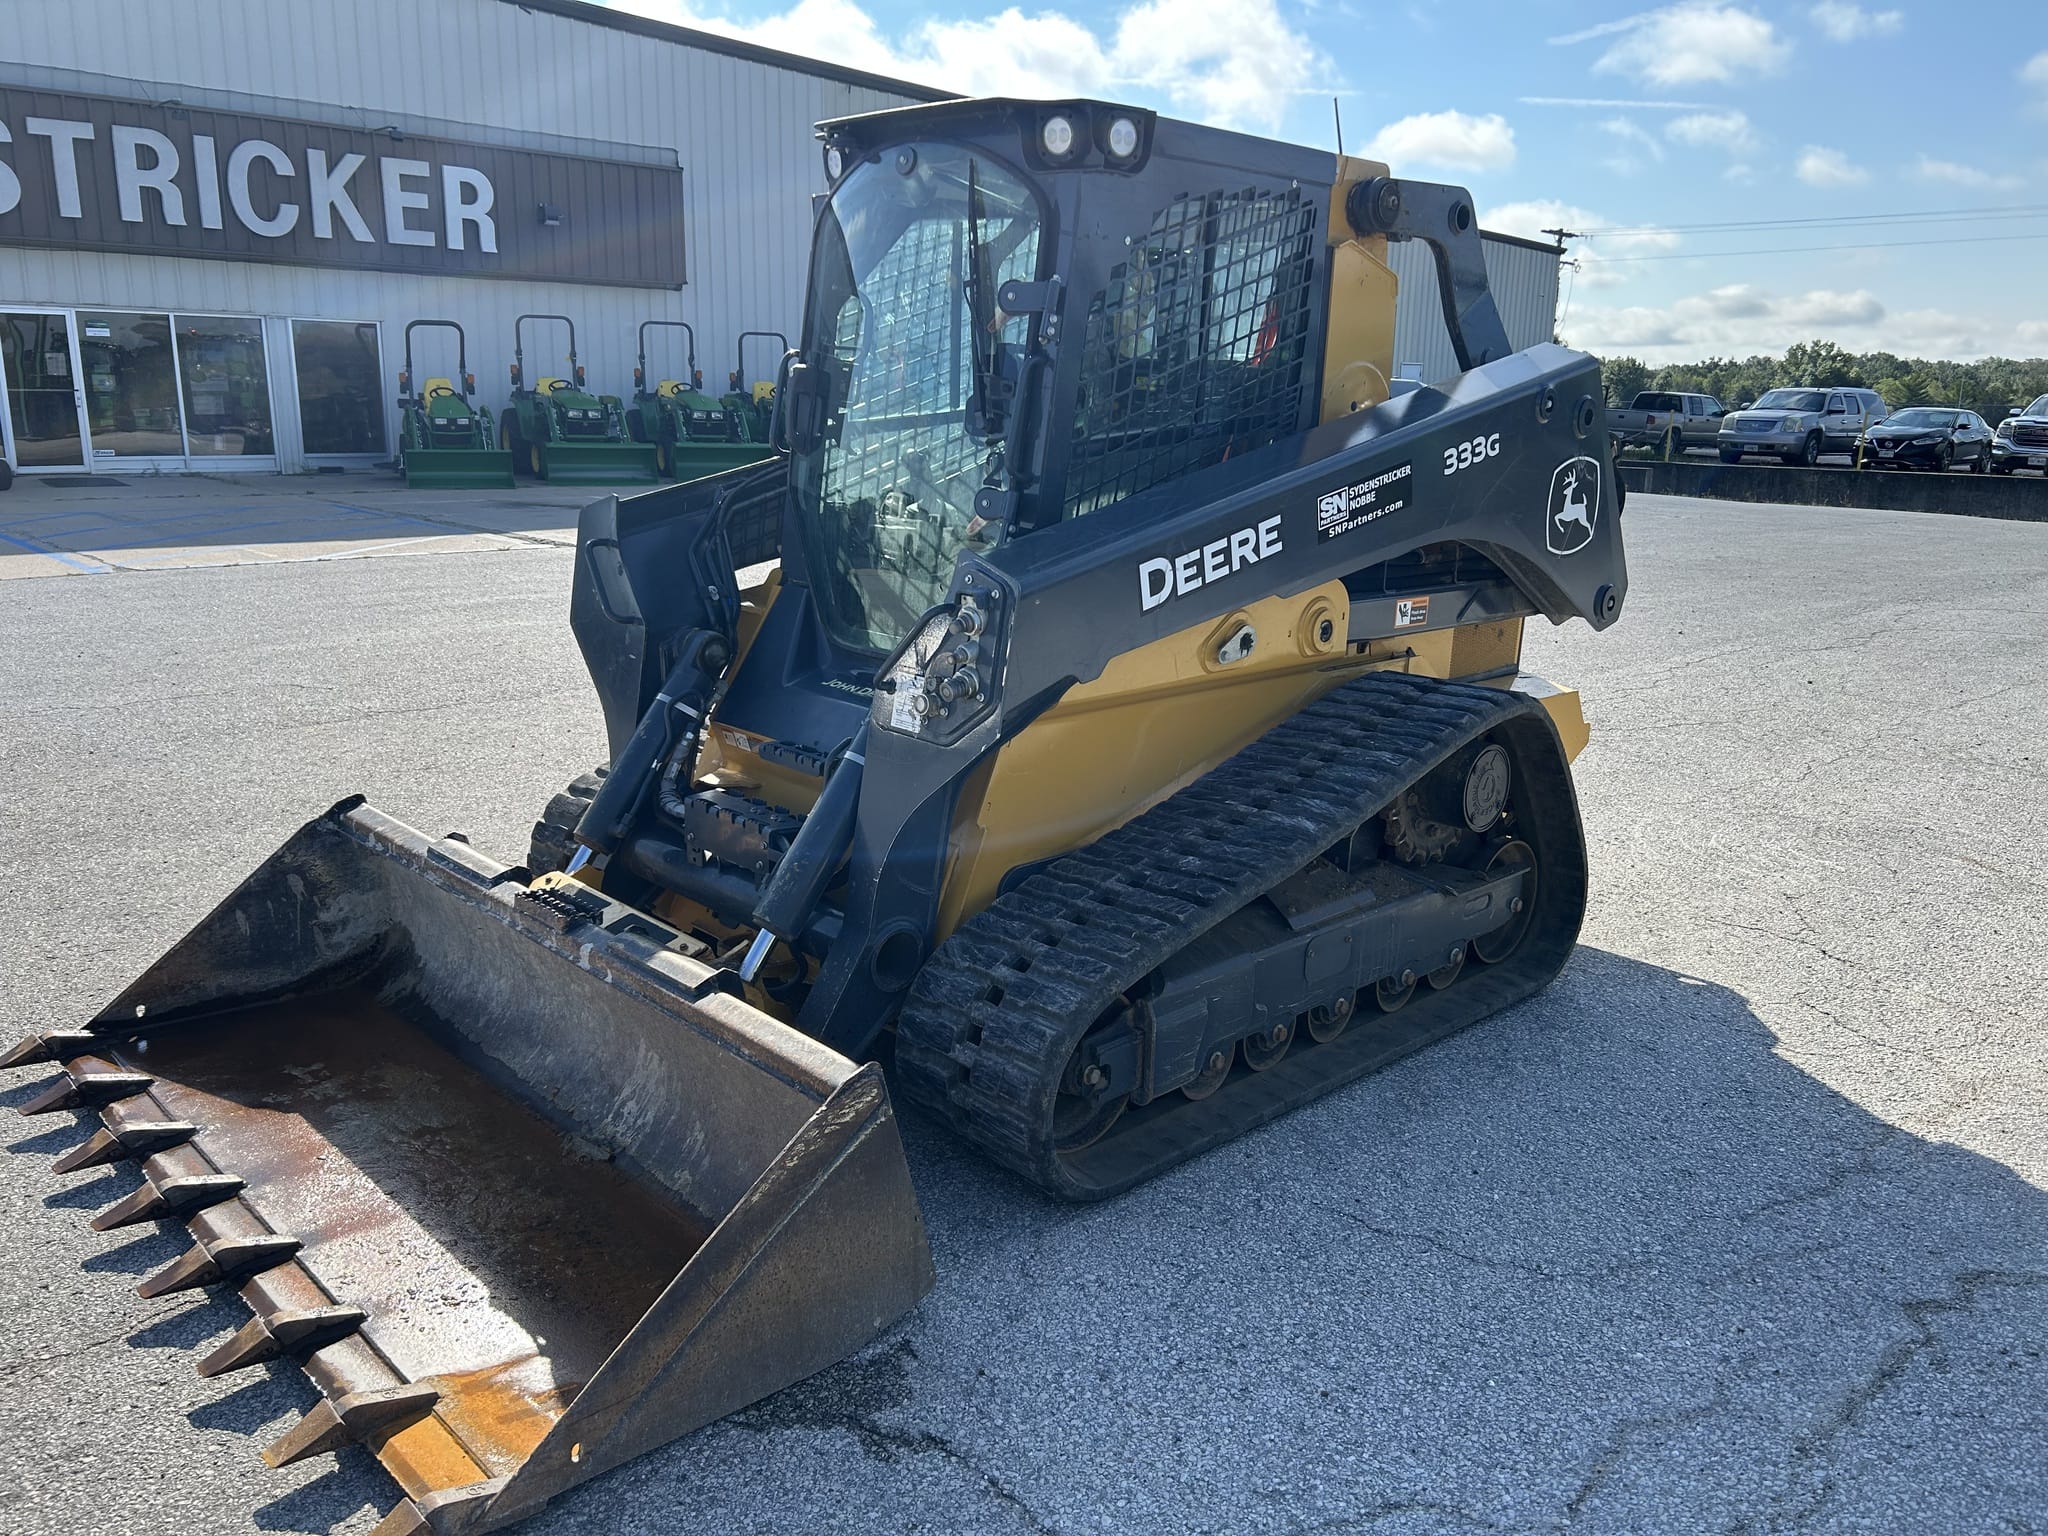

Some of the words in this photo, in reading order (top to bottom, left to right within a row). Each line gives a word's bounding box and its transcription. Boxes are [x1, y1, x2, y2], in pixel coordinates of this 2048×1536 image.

[1444, 433, 1500, 476] 333G
[1349, 465, 1411, 498] SYDENSTRICKER
[1320, 491, 1346, 518] SN
[1350, 491, 1376, 511] NOBBE
[1328, 500, 1403, 537] SNPartners.com
[1139, 514, 1283, 611] DEERE
[821, 678, 860, 692] JOHN
